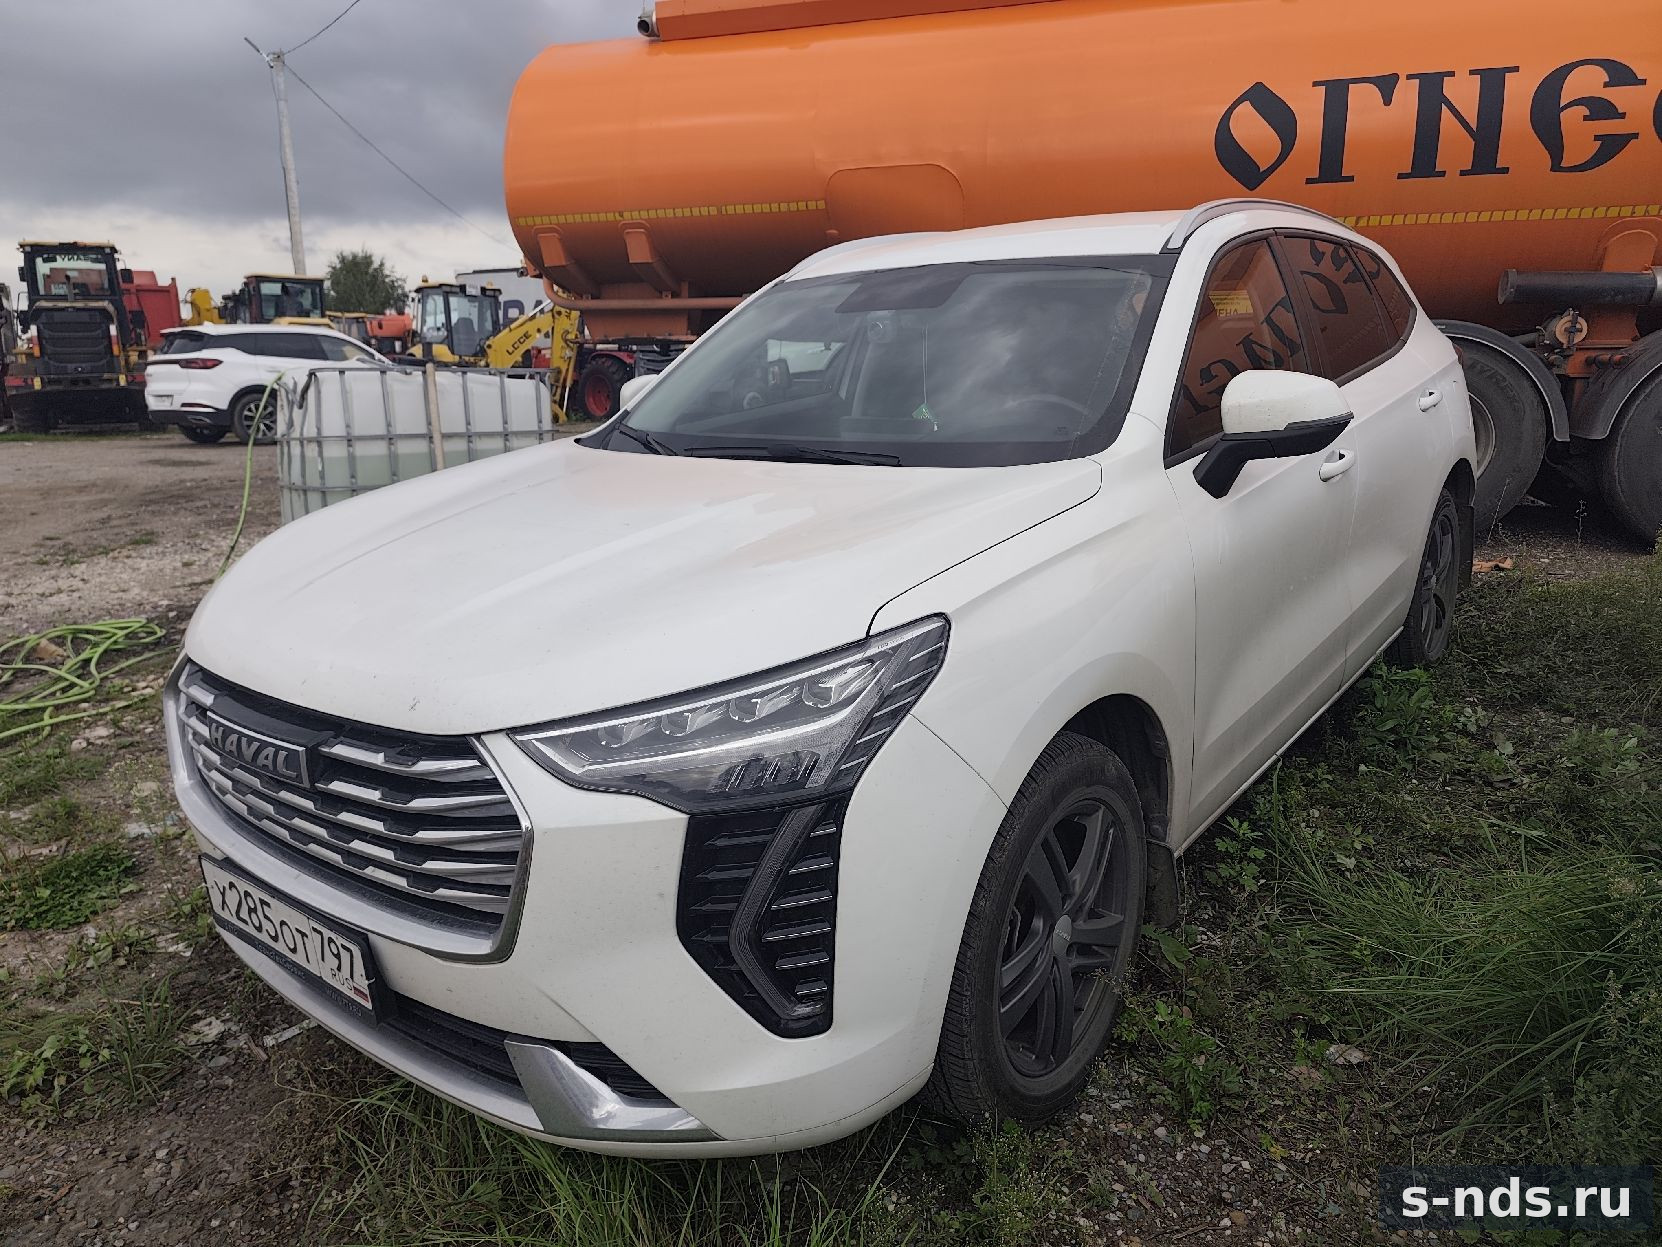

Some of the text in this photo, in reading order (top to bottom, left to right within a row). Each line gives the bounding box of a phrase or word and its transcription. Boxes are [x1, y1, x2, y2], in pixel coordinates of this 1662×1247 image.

[1214, 57, 1662, 191] ОГНЕ
[209, 722, 297, 778] HAVAL
[330, 967, 354, 992] RUS
